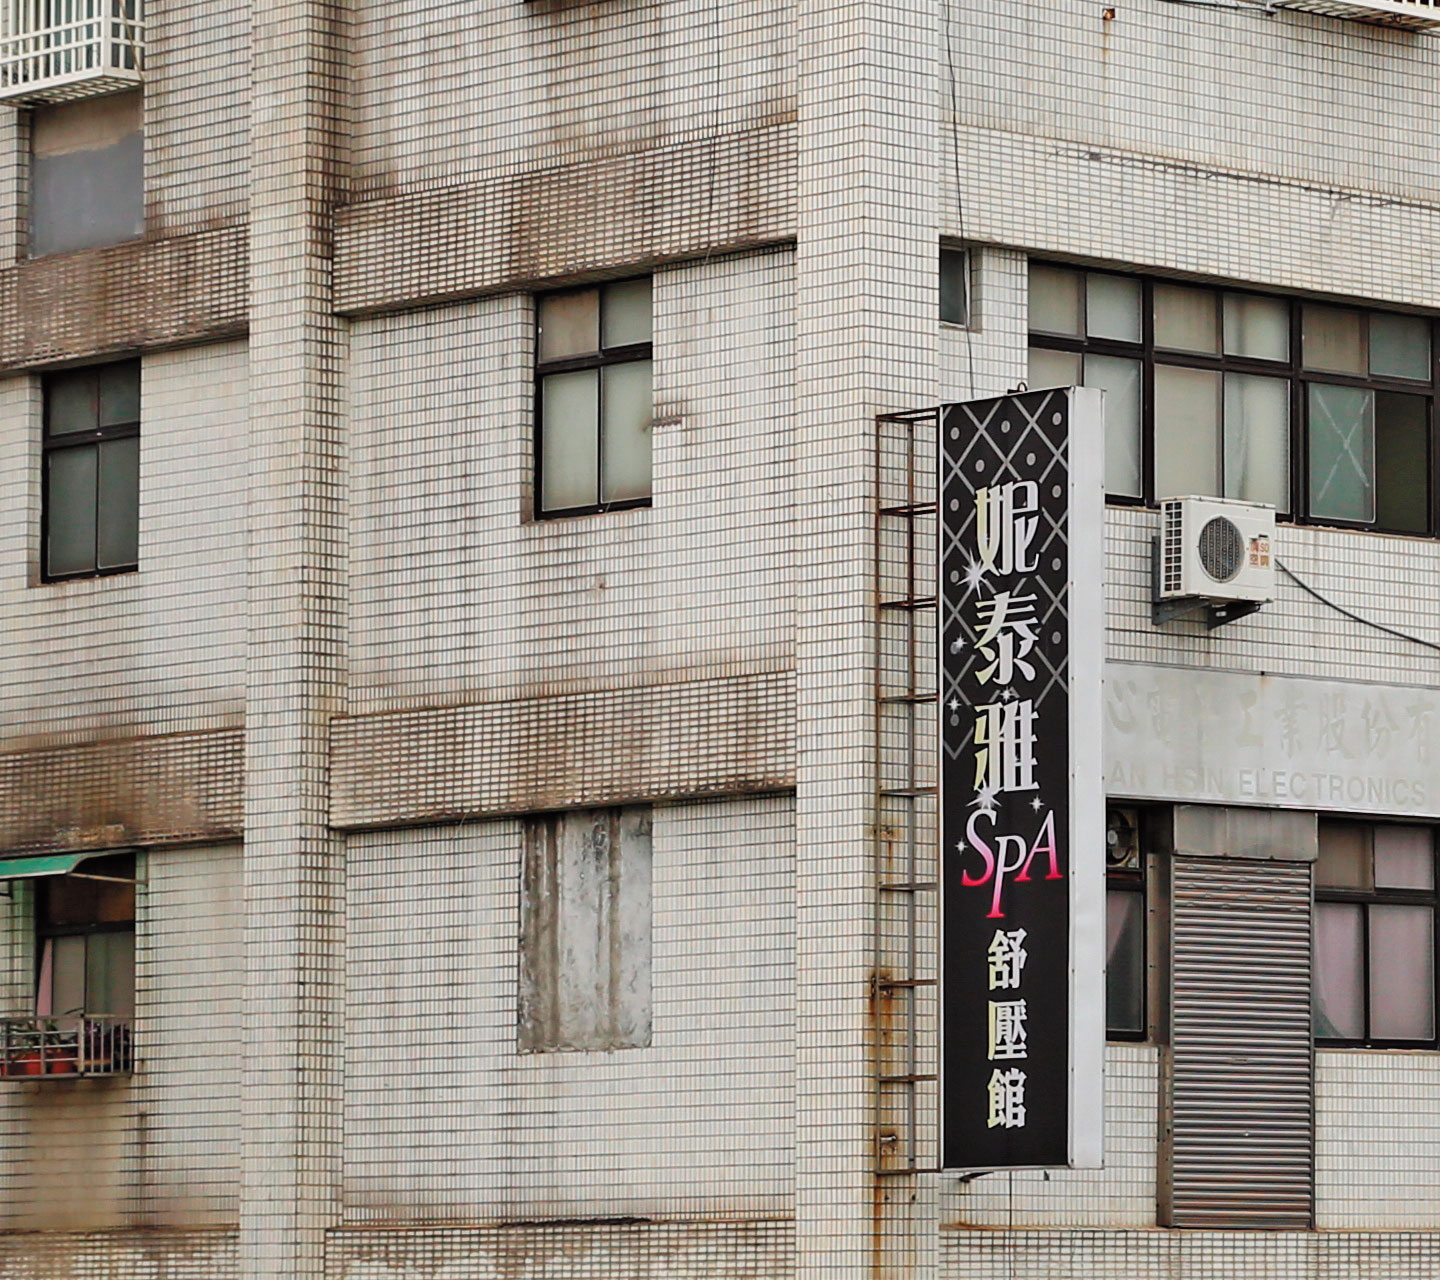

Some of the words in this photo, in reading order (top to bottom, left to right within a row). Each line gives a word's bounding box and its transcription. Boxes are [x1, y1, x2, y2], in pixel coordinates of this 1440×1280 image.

[973, 480, 1040, 794] 妮泰雅
[1238, 769, 1425, 807] ELECTRONICS
[987, 928, 1028, 1129] 舒壓館
